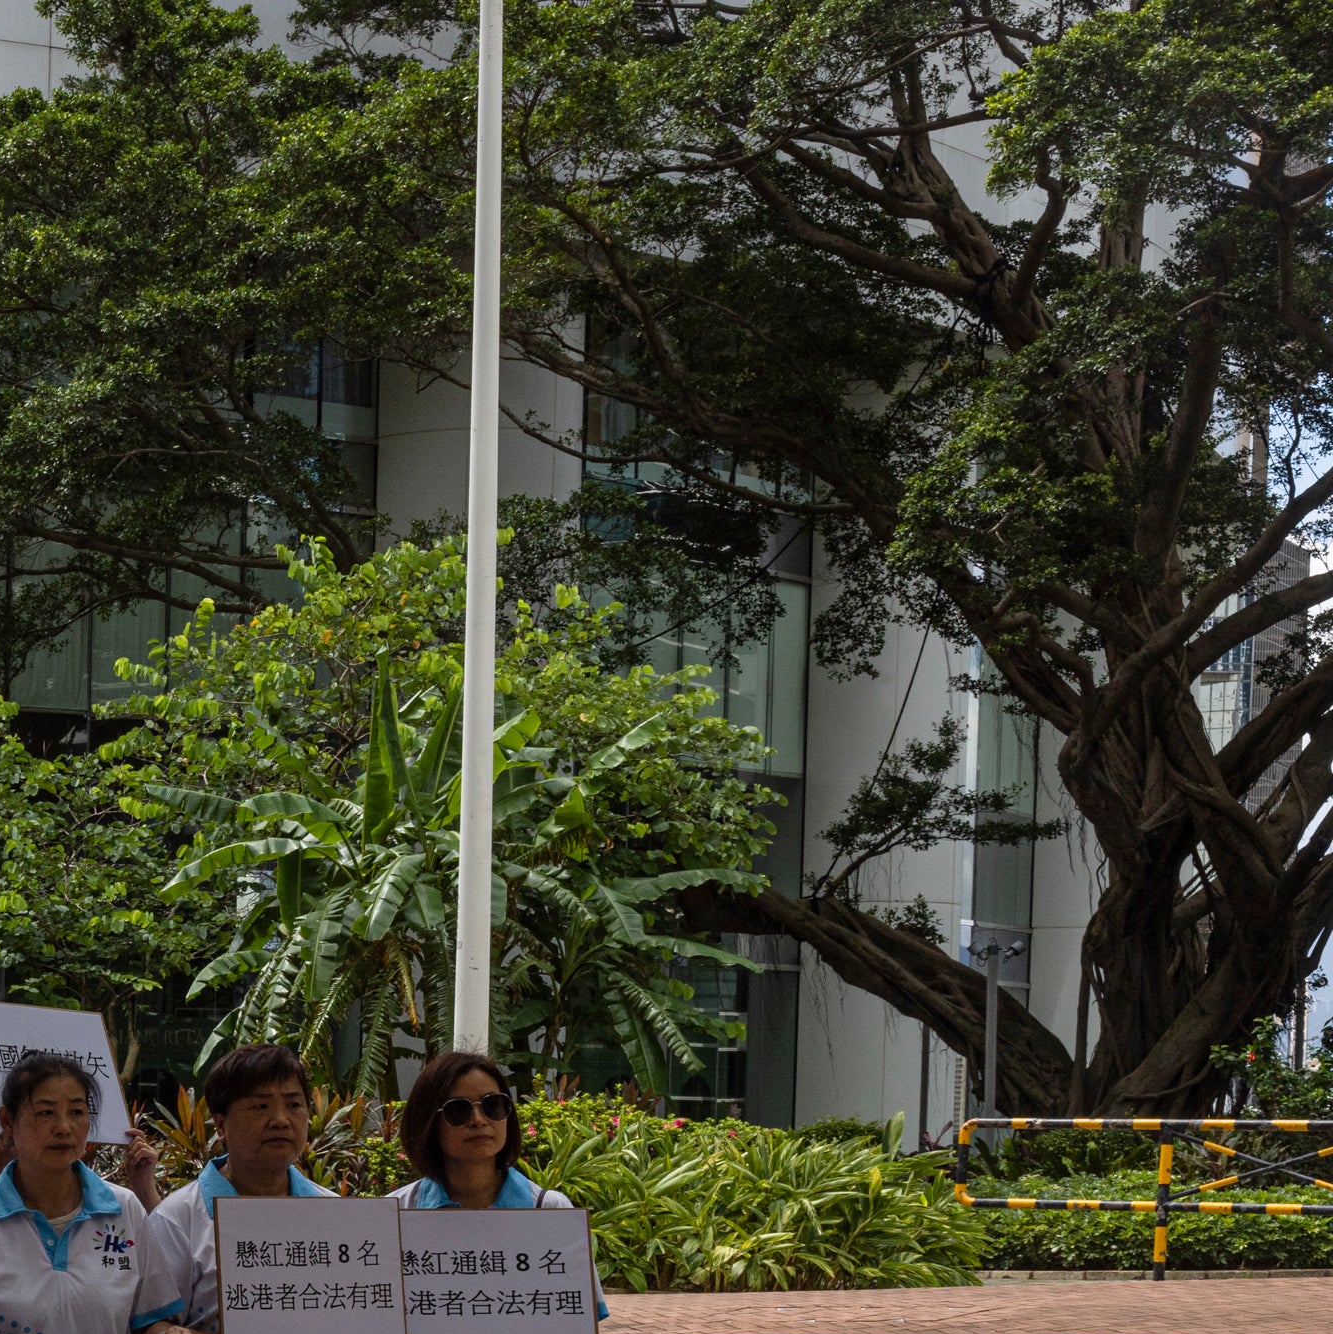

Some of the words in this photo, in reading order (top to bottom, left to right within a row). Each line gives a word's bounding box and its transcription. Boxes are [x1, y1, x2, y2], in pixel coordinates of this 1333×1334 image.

[101, 1255, 132, 1270] 和盟
[337, 1243, 351, 1264] 8
[515, 1252, 530, 1272] 8
[225, 1282, 394, 1312] 逃港者合法有理
[405, 1289, 585, 1316] 港者合法有理
